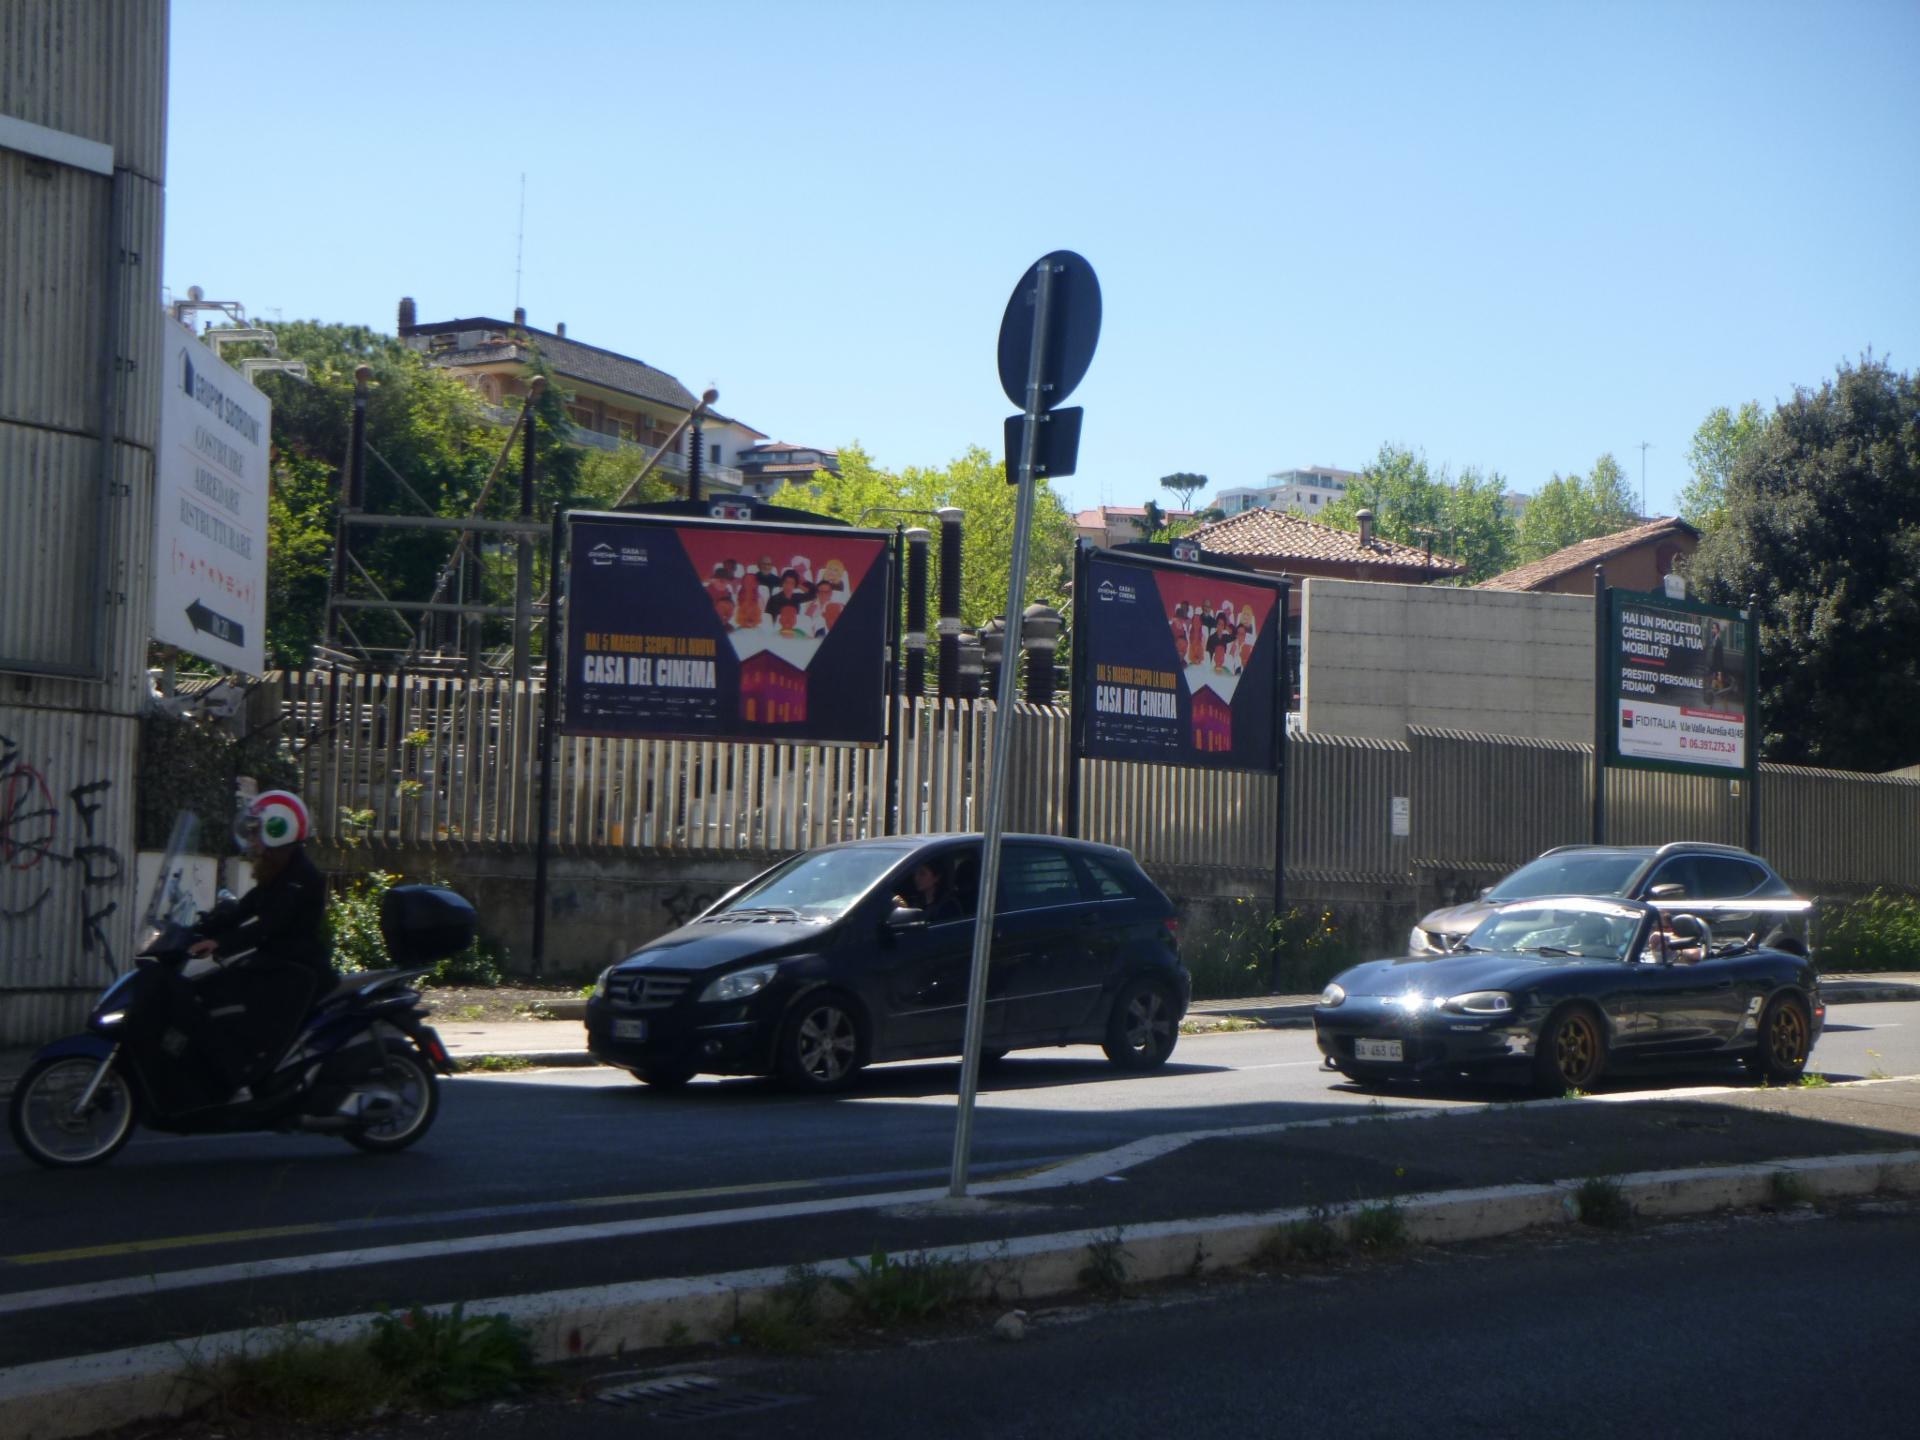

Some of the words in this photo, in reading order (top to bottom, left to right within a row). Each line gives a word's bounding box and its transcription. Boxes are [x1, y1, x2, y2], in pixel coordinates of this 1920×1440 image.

[1622, 611, 1639, 626] HAI
[1641, 614, 1654, 628] UN
[1655, 618, 1701, 636] PROGETTO
[1622, 626, 1652, 641] GREEN
[1654, 632, 1672, 645] PER
[1673, 634, 1685, 647] LA
[1686, 636, 1703, 650] TUA
[584, 655, 625, 685] CASA
[629, 657, 652, 686] DEL
[656, 659, 716, 689] CINEMA
[1622, 668, 1658, 682] PRESTITO
[1659, 673, 1703, 689] PERSONALE
[1622, 680, 1655, 694] FIDIAMO
[1096, 685, 1121, 713] CASA
[1123, 688, 1138, 715] DEL
[1140, 690, 1177, 719] CINEMA
[1635, 715, 1677, 730] FIDITALIA
[1691, 723, 1706, 736] Valle
[1706, 725, 1727, 738] Aurelia
